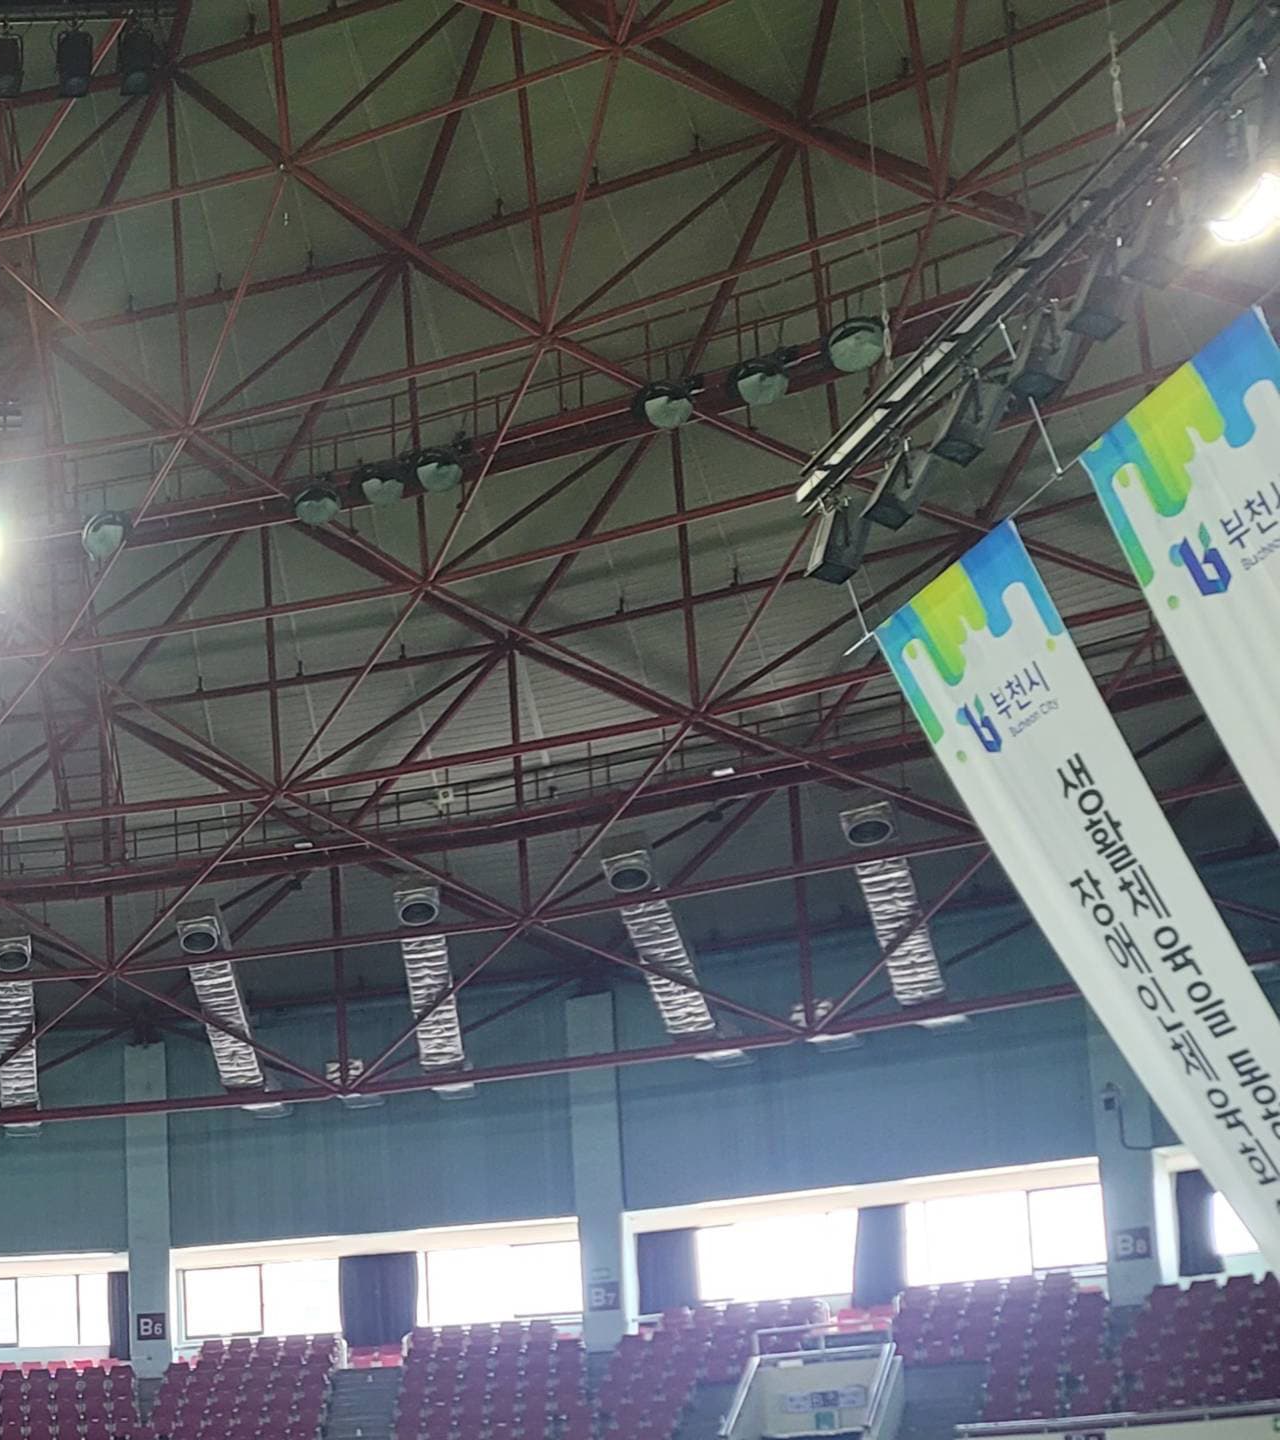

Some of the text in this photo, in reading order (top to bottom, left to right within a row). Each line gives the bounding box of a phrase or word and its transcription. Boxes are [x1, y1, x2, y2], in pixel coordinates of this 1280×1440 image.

[990, 660, 1051, 720] 부천시
[1056, 752, 1237, 1040] 생활체육을
[1069, 869, 1280, 1187] 장애인체육회
[139, 1318, 163, 1336] B6
